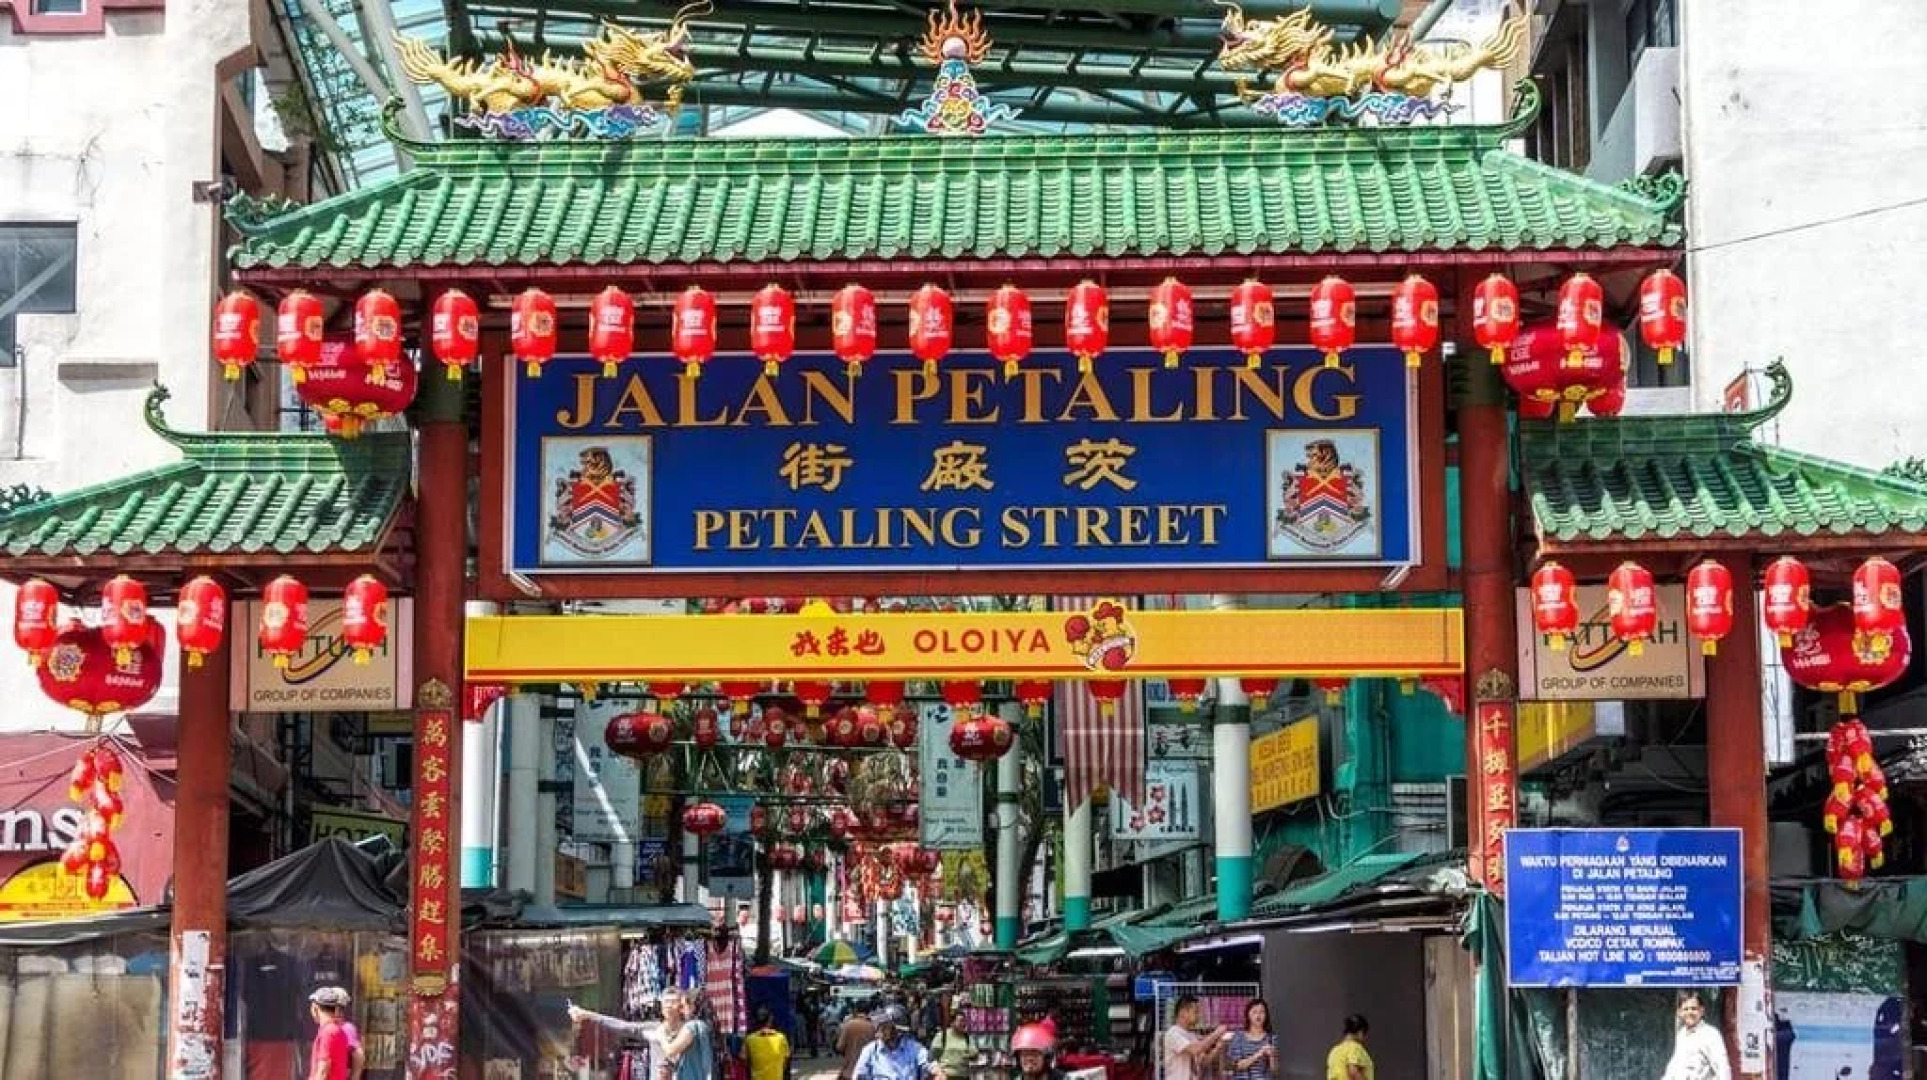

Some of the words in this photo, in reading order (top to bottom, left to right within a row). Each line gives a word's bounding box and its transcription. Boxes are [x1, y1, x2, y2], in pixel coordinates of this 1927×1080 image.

[556, 369, 858, 428] JALAN
[889, 364, 1361, 425] PETALING
[692, 508, 983, 549] PETALING
[1001, 505, 1227, 547] STREET
[913, 629, 1051, 653] OLOIYA
[1541, 676, 1586, 690] GROUP
[1589, 676, 1606, 689] OF
[1610, 674, 1685, 688] COMPANIES
[253, 688, 295, 703] GROUP
[300, 688, 315, 701] OF
[319, 686, 392, 700] COMPANIES
[1520, 855, 1557, 867] WAKTU
[1630, 855, 1657, 867] YANG
[1660, 855, 1727, 867] DIBENARKAN
[1587, 868, 1621, 879] JALAN
[1624, 868, 1673, 879] PETALING
[1574, 925, 1626, 936] DILARANG
[1630, 925, 1676, 936] MENJUAL
[1606, 937, 1640, 949] CETAK
[1538, 950, 1576, 962] TALIAN
[1578, 950, 1599, 962] HOT
[1603, 950, 1625, 962] LINE
[1629, 950, 1643, 962] NO
